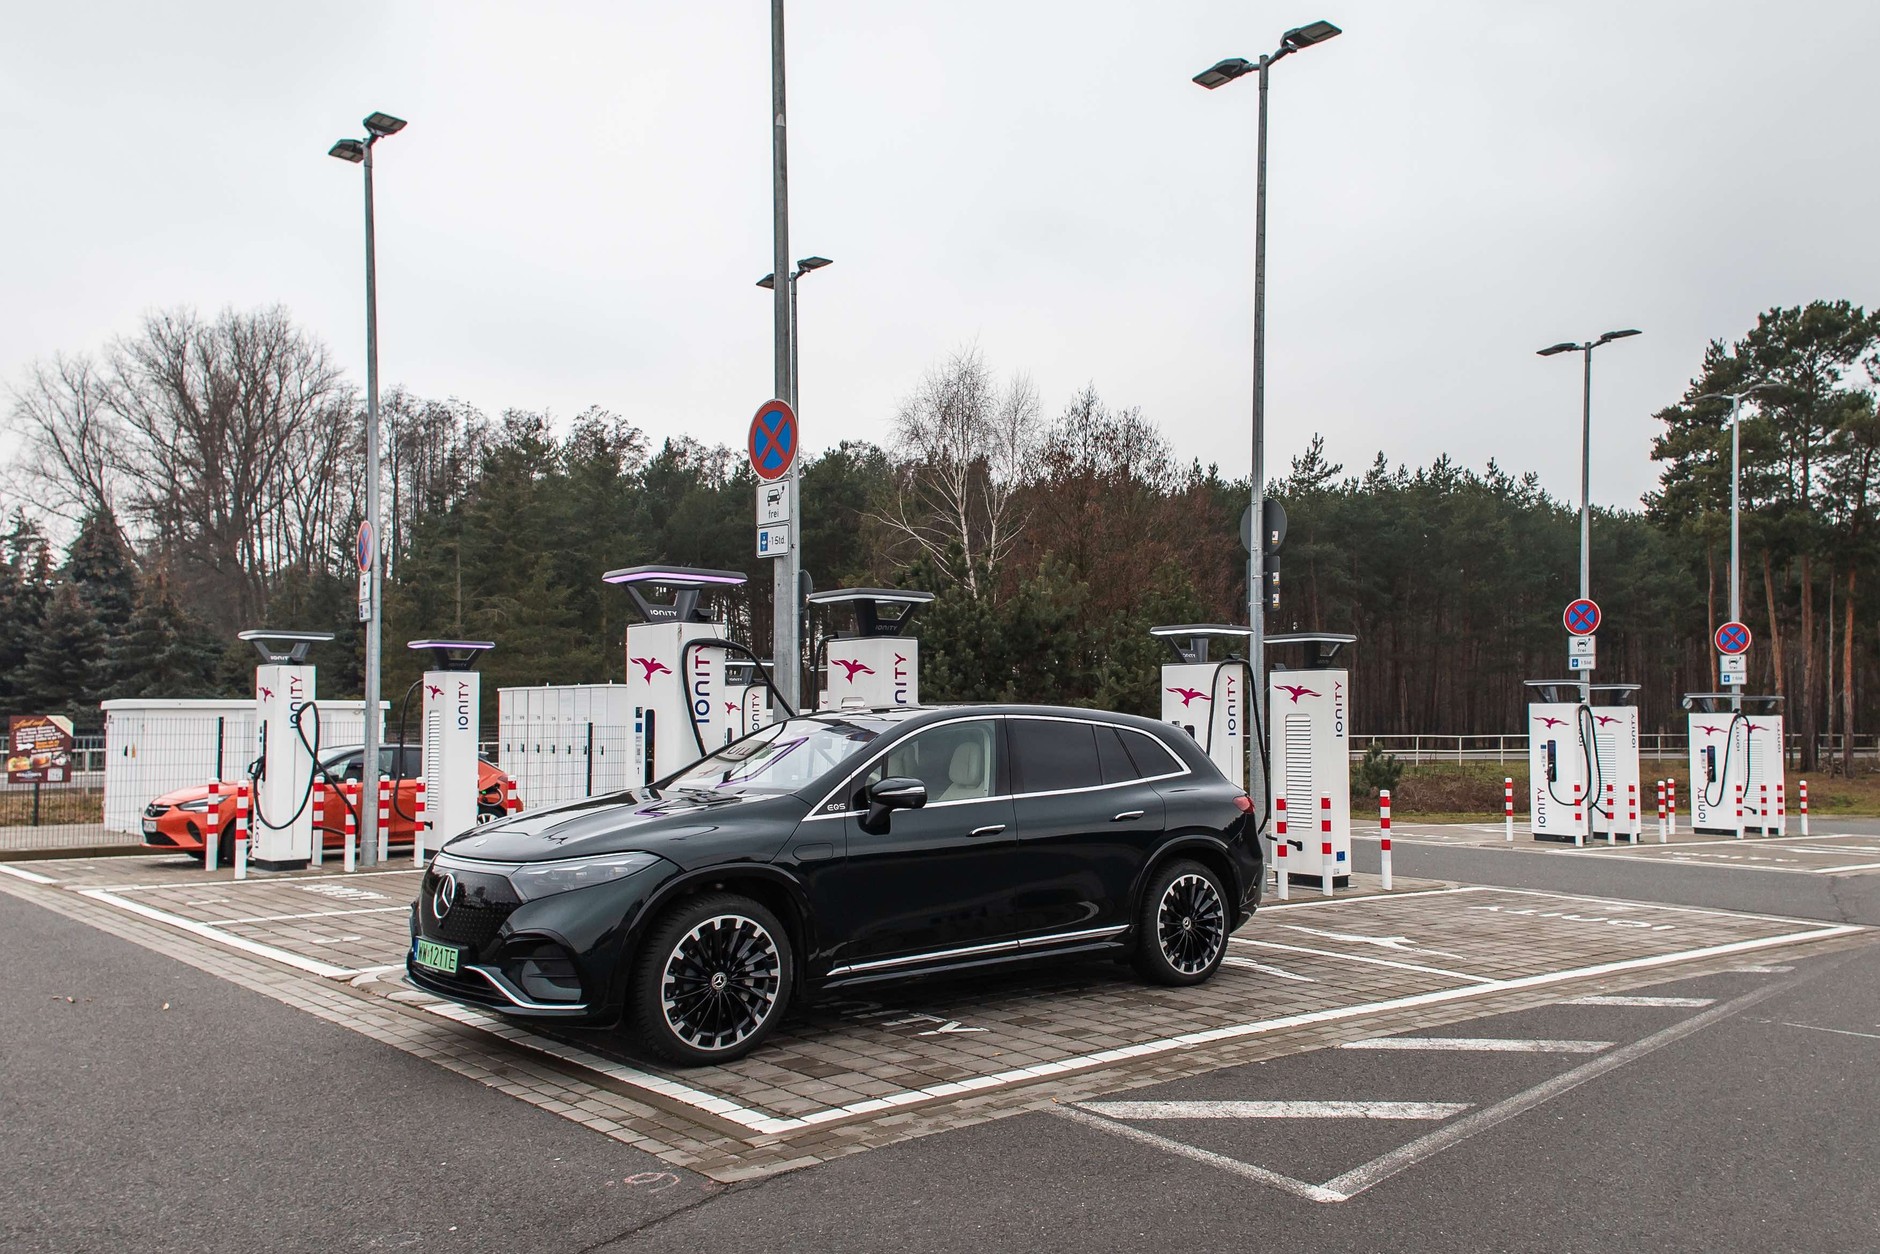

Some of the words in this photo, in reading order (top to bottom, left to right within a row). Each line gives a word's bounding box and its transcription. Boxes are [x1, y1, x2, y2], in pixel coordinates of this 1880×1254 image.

[768, 509, 780, 519] frei
[650, 609, 678, 617] IONITY
[894, 653, 907, 705] NITY
[458, 681, 469, 731] IONITY
[751, 693, 760, 731] ONITY
[1227, 675, 1237, 736] IONITY
[1334, 681, 1344, 738] IONITY
[827, 803, 846, 811] EQS
[1537, 787, 1547, 828] IONITY
[1697, 787, 1707, 823] IONITY
